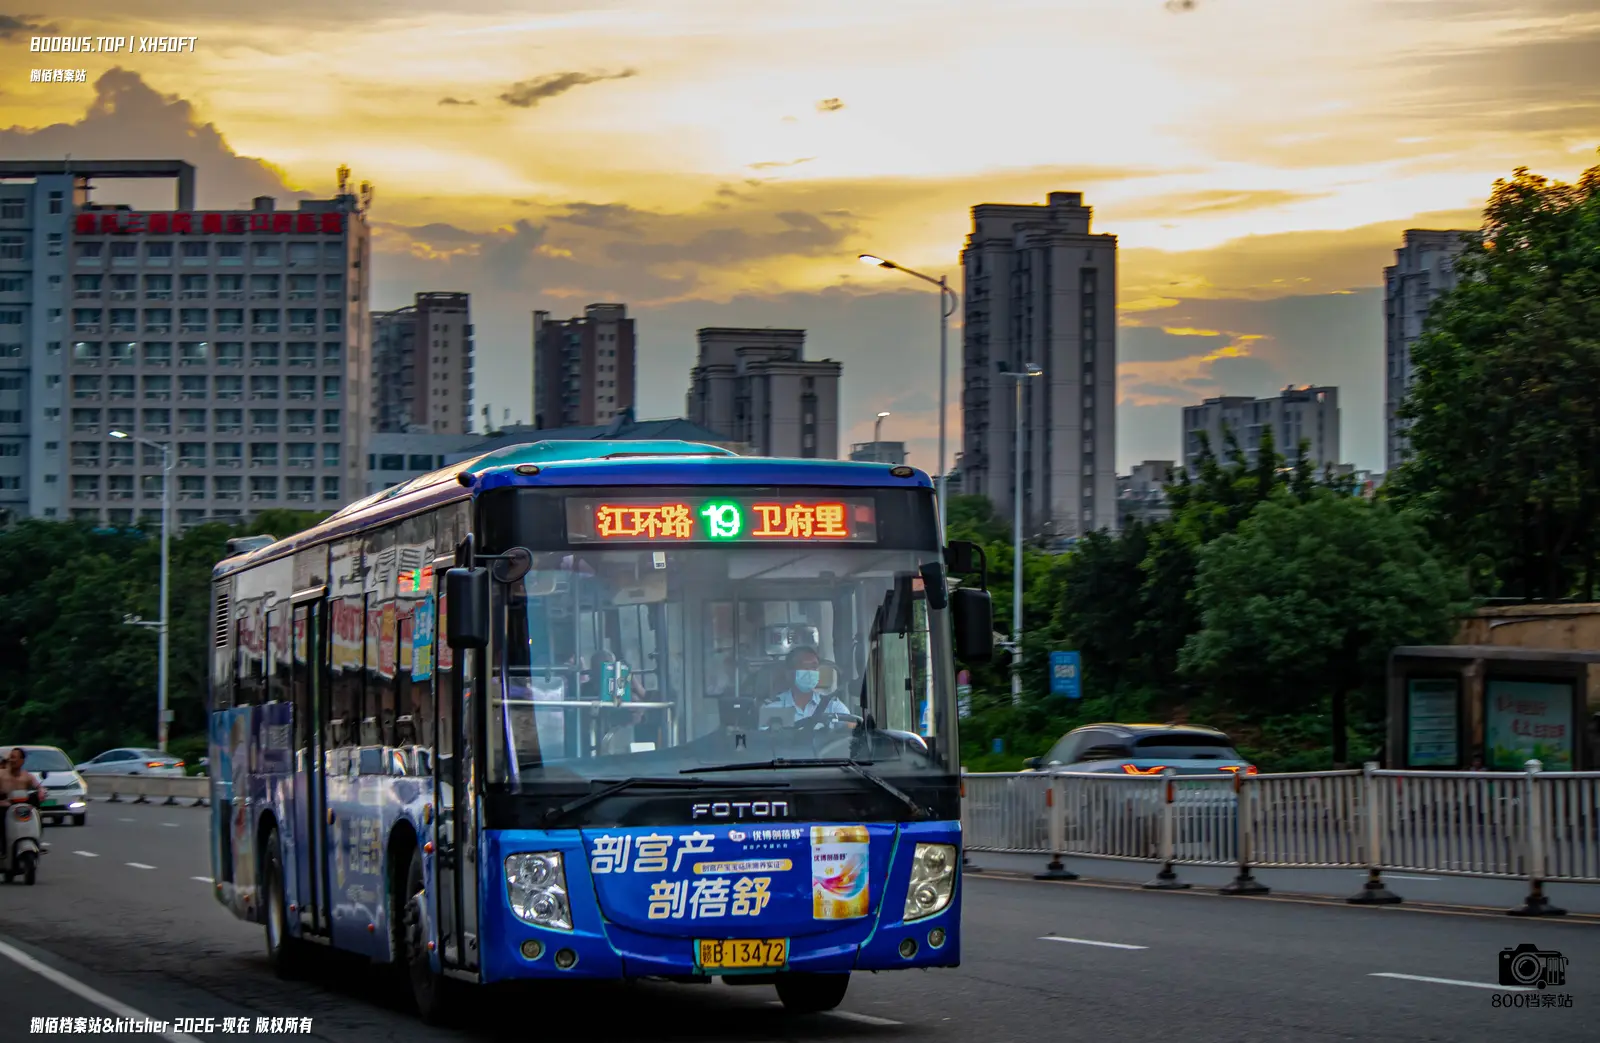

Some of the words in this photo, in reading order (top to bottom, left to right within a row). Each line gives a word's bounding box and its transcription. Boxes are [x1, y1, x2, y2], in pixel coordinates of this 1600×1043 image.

[597, 504, 693, 539] 江环路
[701, 504, 741, 539] 19
[751, 504, 848, 538] 卫府里
[692, 801, 789, 819] FOTON
[591, 831, 716, 874] 剖宫产
[648, 877, 772, 920] 剖蓓舒
